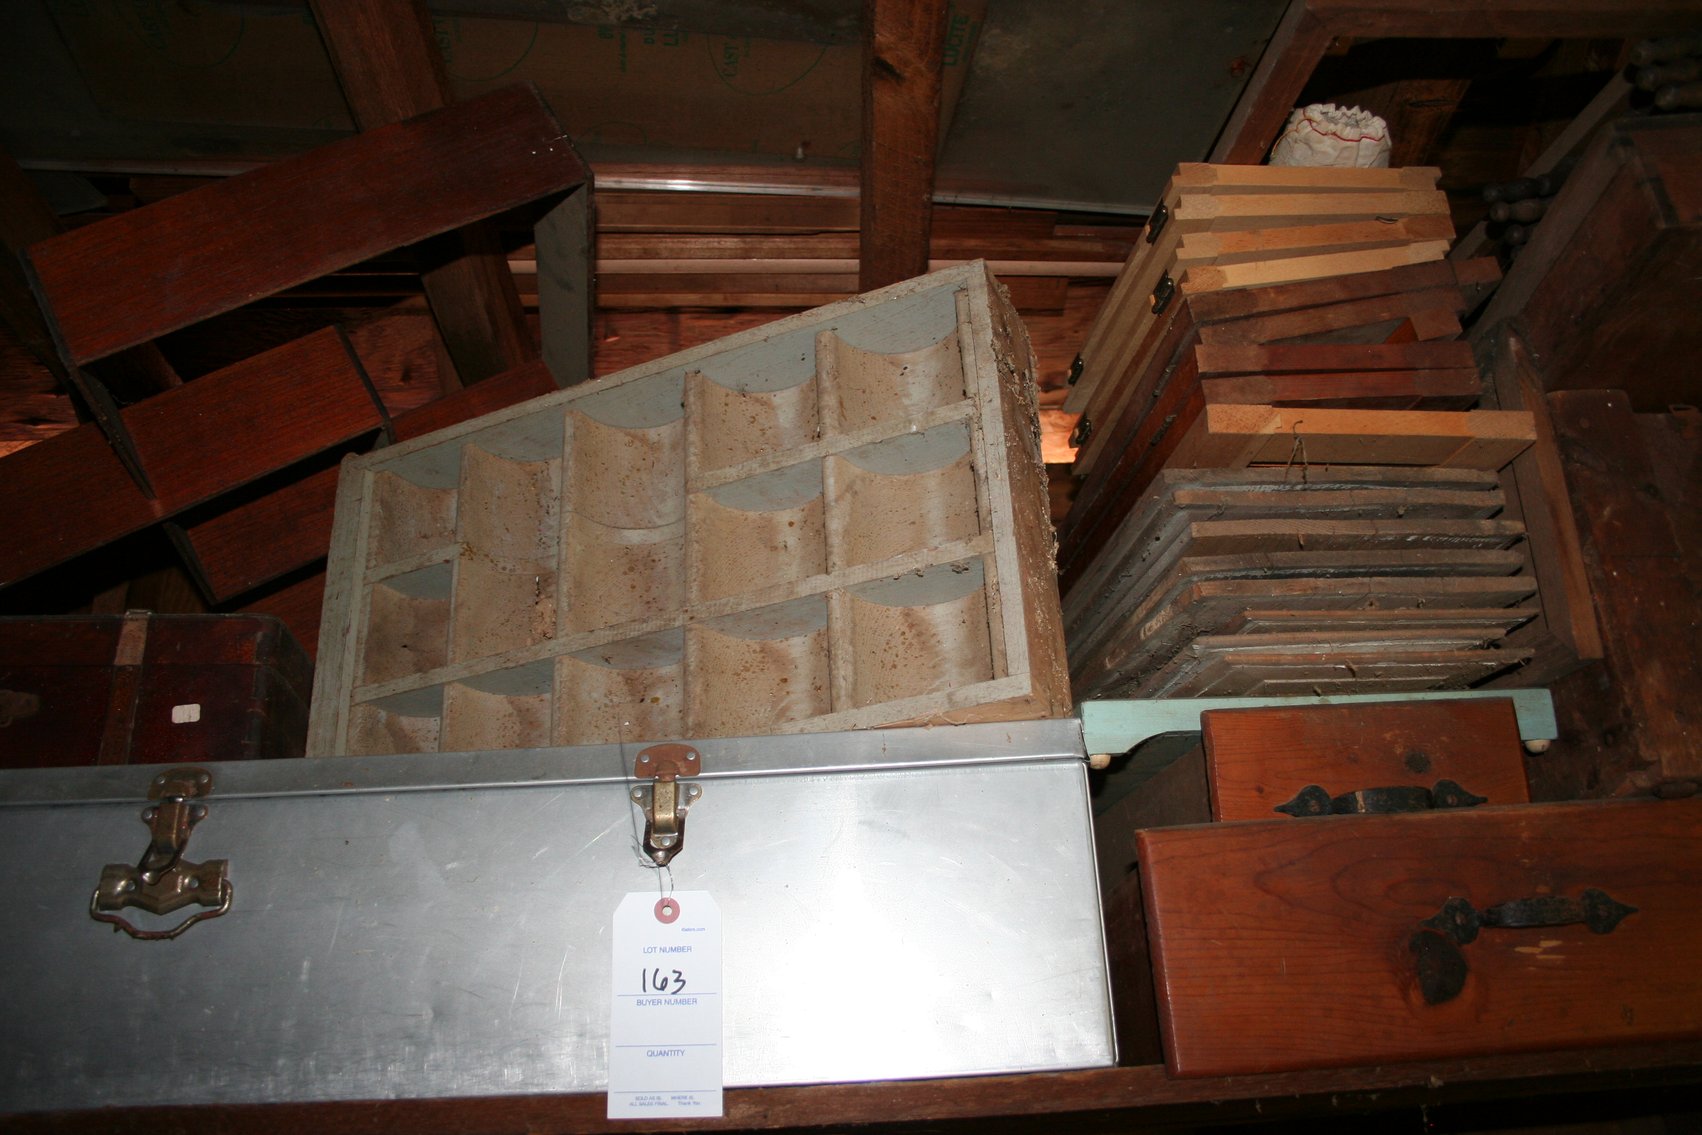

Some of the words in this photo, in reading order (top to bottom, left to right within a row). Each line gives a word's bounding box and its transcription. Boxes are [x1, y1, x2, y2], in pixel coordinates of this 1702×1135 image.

[942, 15, 969, 66] LUCITE
[642, 946, 658, 954] LOT
[659, 945, 692, 953] NUMBER
[642, 967, 687, 995] 163
[664, 998, 698, 1006] NUMBER
[646, 1049, 685, 1058] QUANTITY
